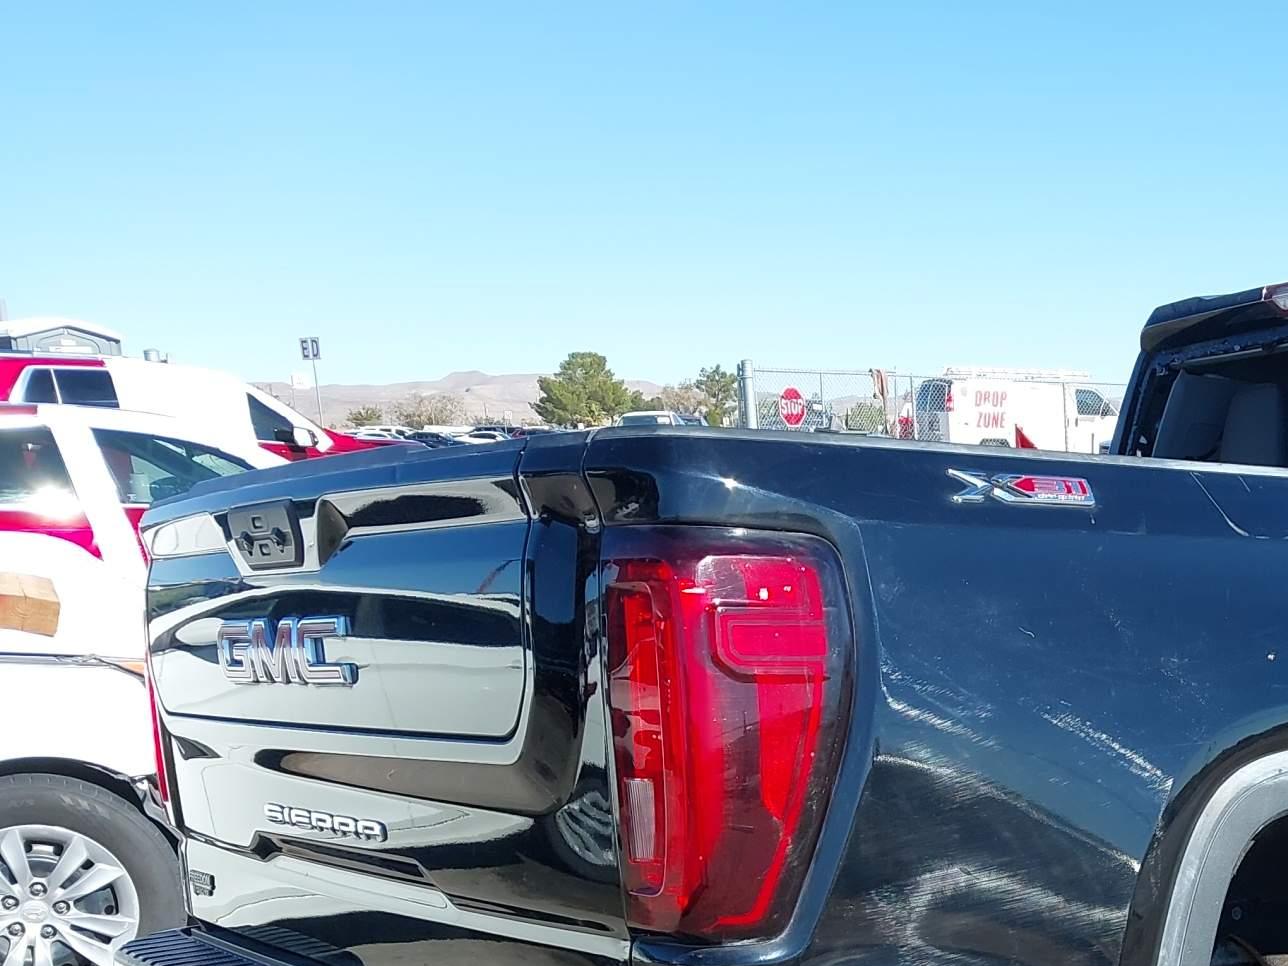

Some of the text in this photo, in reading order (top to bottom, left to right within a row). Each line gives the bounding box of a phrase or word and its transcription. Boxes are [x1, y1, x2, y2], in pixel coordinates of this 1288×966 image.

[781, 399, 804, 415] STOP
[975, 390, 1007, 407] DROP
[976, 411, 1007, 428] ZONE
[217, 615, 360, 688] GMC
[263, 802, 388, 842] SIERRA
